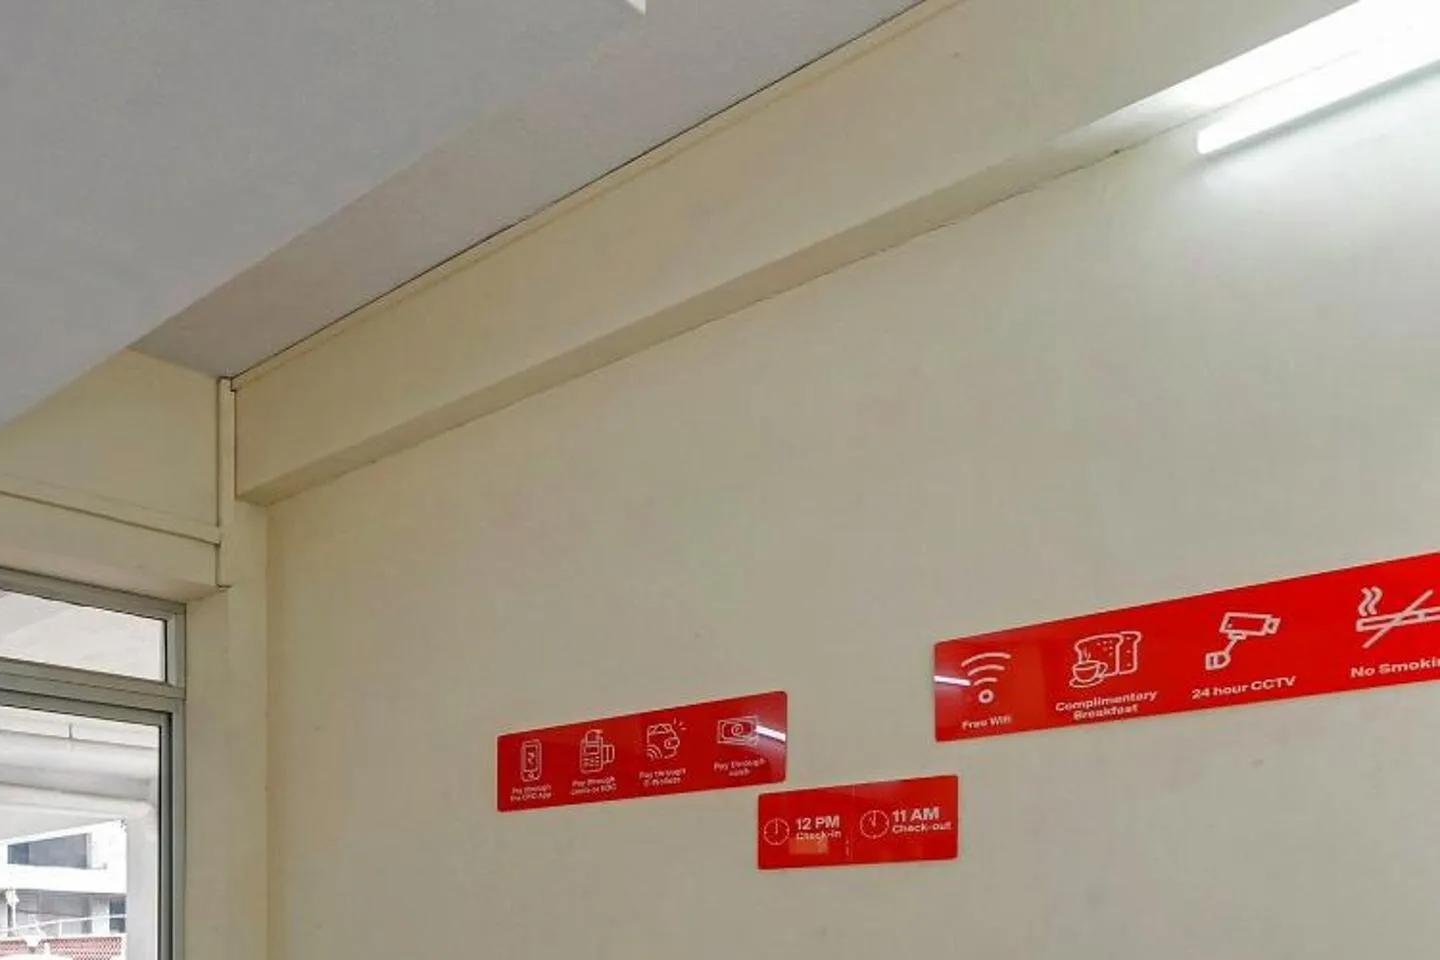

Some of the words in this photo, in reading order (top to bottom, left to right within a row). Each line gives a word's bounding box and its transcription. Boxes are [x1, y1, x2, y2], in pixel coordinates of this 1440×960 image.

[1349, 666, 1376, 679] No
[1378, 655, 1440, 675] Smoki
[1191, 687, 1211, 700] 24
[1213, 683, 1249, 696] hour
[1250, 675, 1297, 692] CCTV
[1055, 689, 1159, 712] Complimentary
[1072, 703, 1139, 721] Breakfast
[961, 718, 989, 730] Free
[795, 817, 812, 830] 12
[815, 814, 840, 829] PM
[892, 808, 907, 823] 11
[910, 805, 940, 821] AM
[795, 829, 842, 841] Check-in
[892, 820, 952, 834] Check-out
